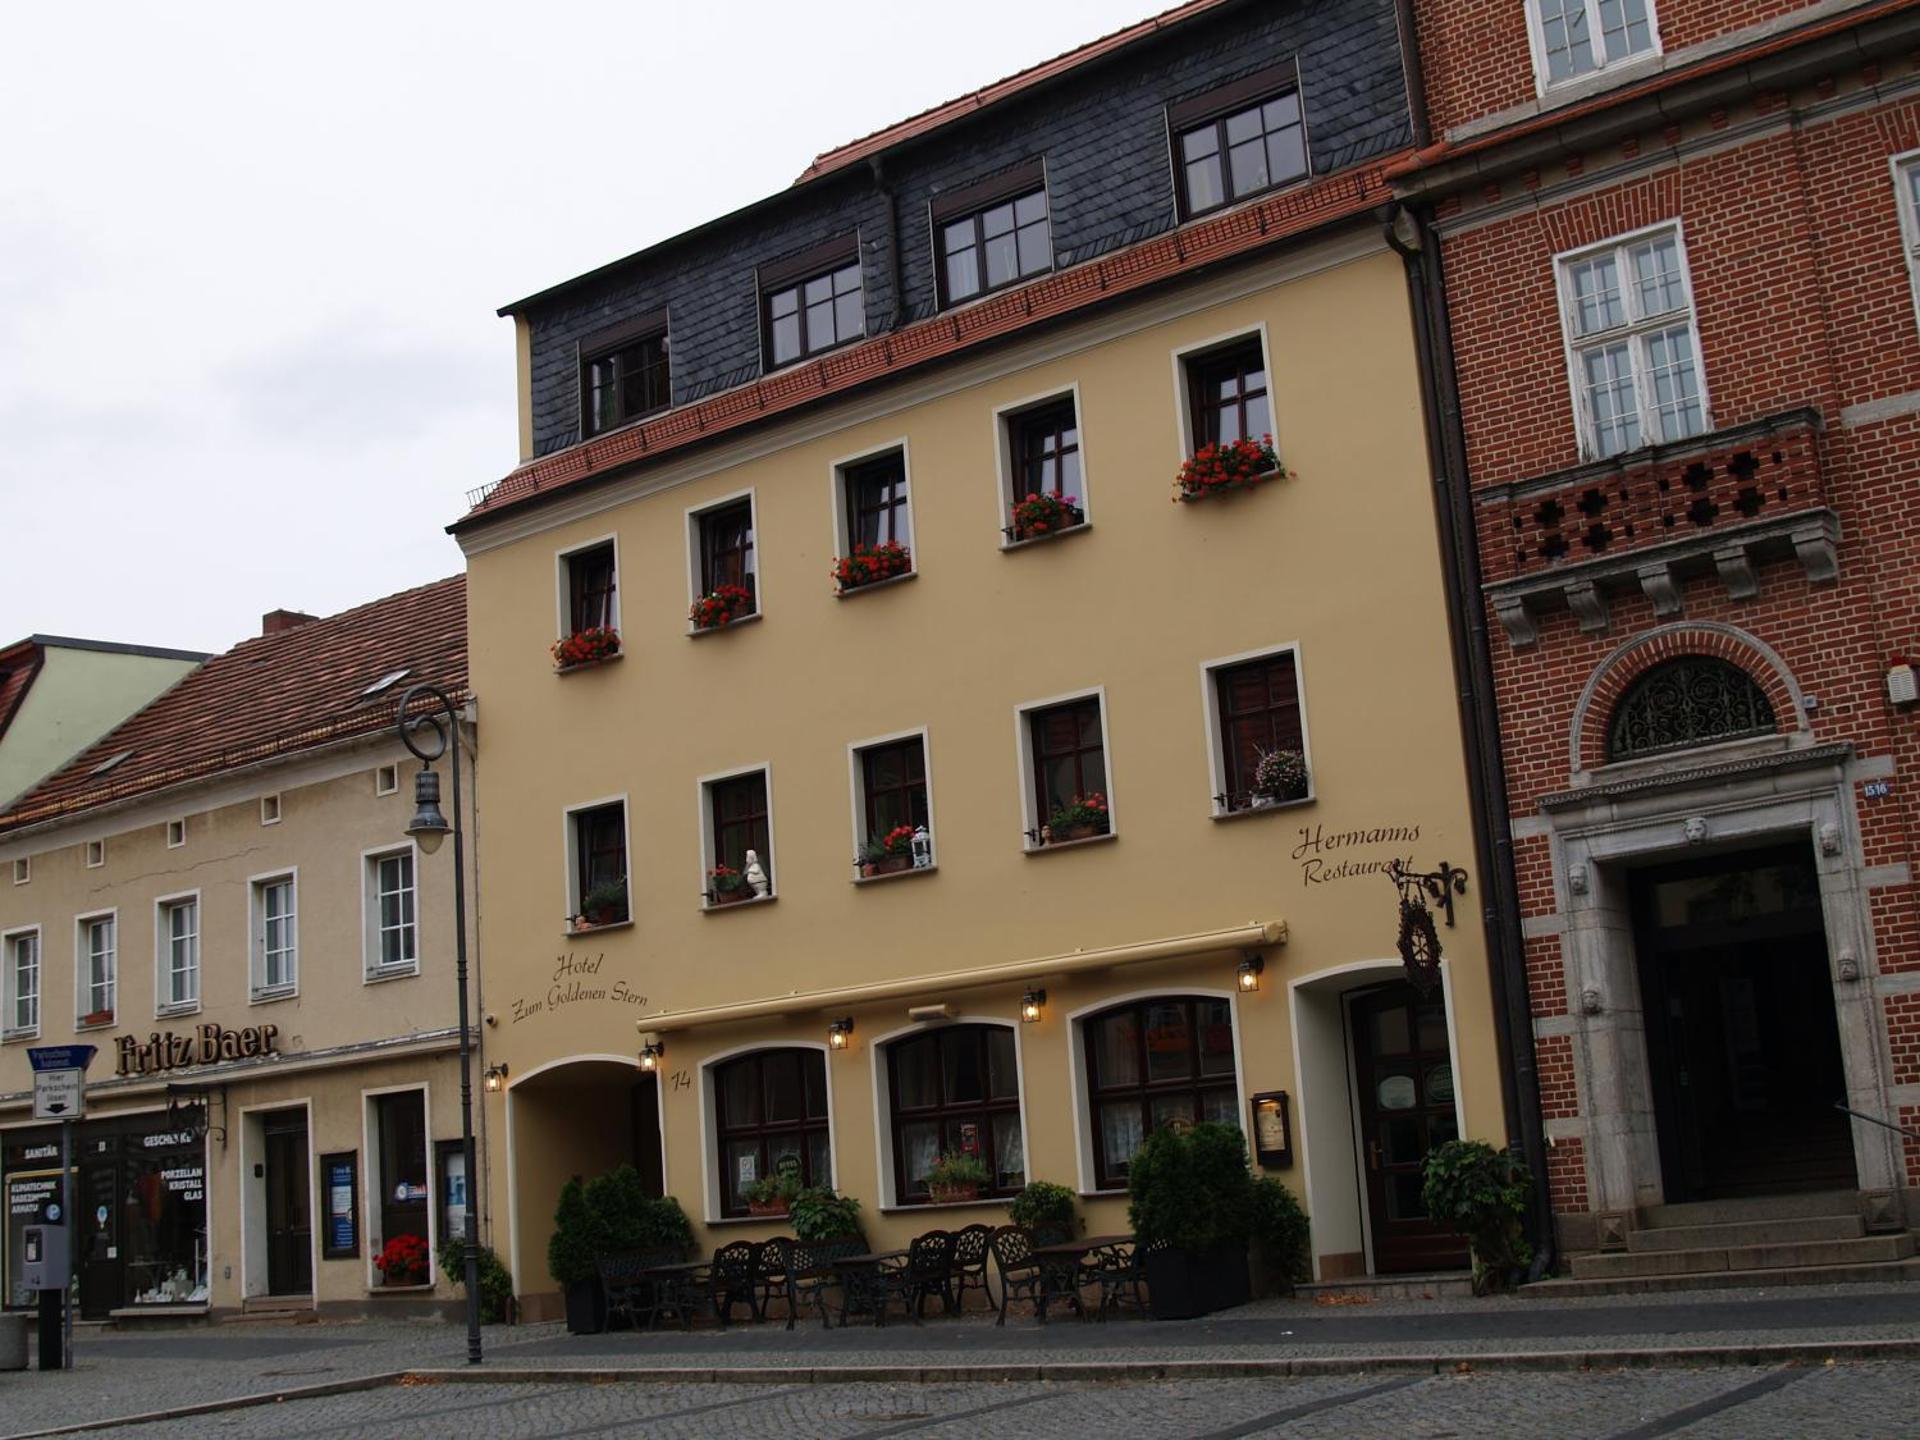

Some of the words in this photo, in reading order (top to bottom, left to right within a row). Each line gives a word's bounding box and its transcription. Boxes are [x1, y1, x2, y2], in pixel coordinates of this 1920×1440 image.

[1291, 824, 1420, 859] Hermanns
[553, 952, 604, 981] Hotel
[512, 999, 542, 1024] Zum
[547, 982, 606, 1011] Goldenen
[611, 981, 648, 1006] Stern
[113, 1031, 193, 1076] Fritz
[196, 1023, 278, 1064] Baer
[671, 1070, 691, 1091] 14
[161, 1167, 203, 1179] PORZELLAN
[169, 1179, 203, 1191] KRISTALL
[184, 1190, 203, 1201] GLAS
